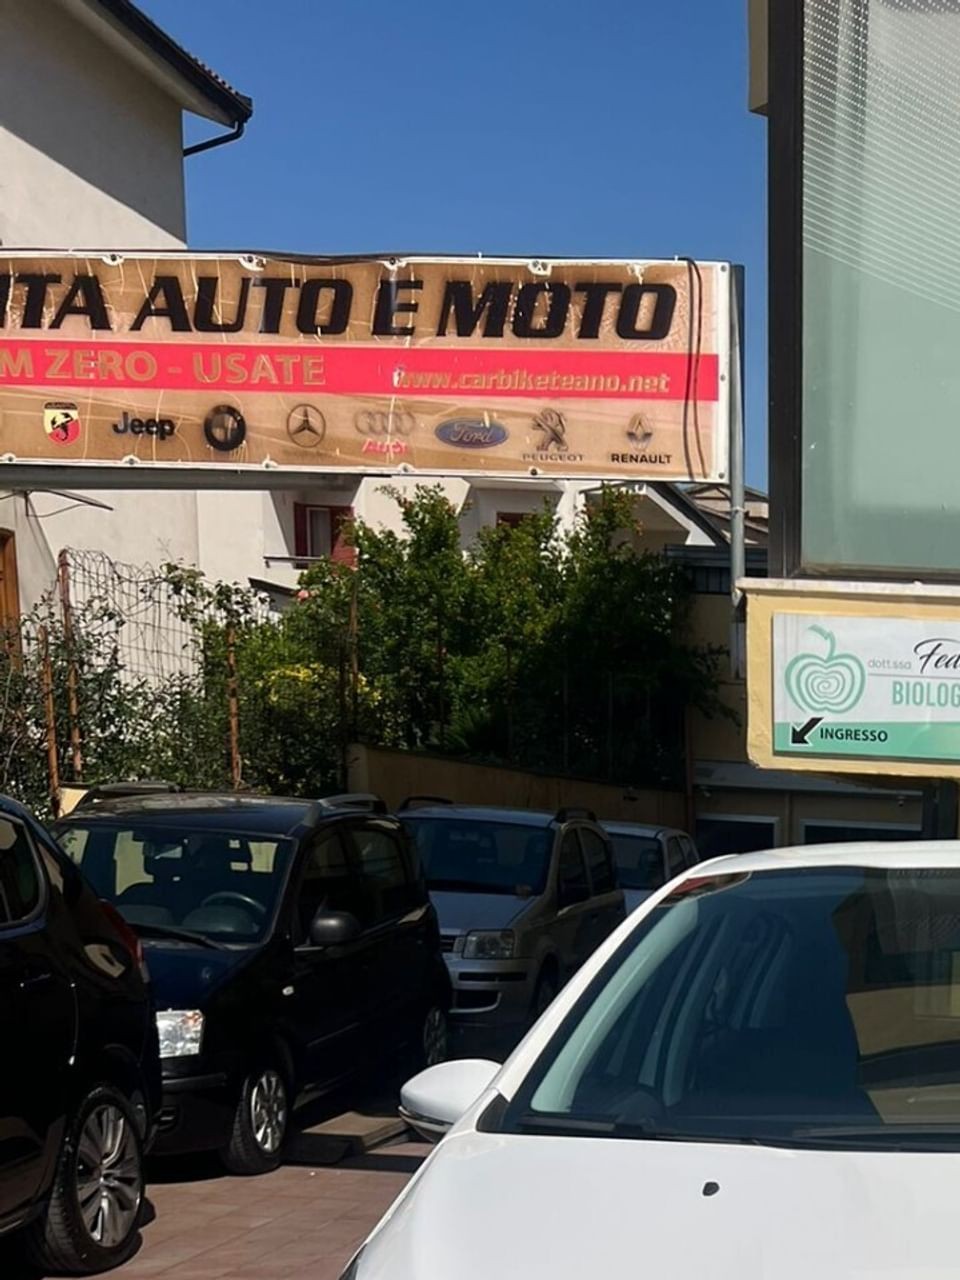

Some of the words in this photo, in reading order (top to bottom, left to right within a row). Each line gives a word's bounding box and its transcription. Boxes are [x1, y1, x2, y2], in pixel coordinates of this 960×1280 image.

[129, 275, 354, 335] AUTO
[371, 280, 423, 337] E
[436, 281, 677, 341] MOTO
[44, 349, 158, 380] ZERO
[192, 353, 326, 385] USATE
[111, 411, 175, 441] Jeep
[449, 422, 494, 444] Ford
[522, 453, 584, 462] PEUGEOT
[611, 453, 673, 465] RENAULT
[819, 726, 889, 743] INGRESSO
